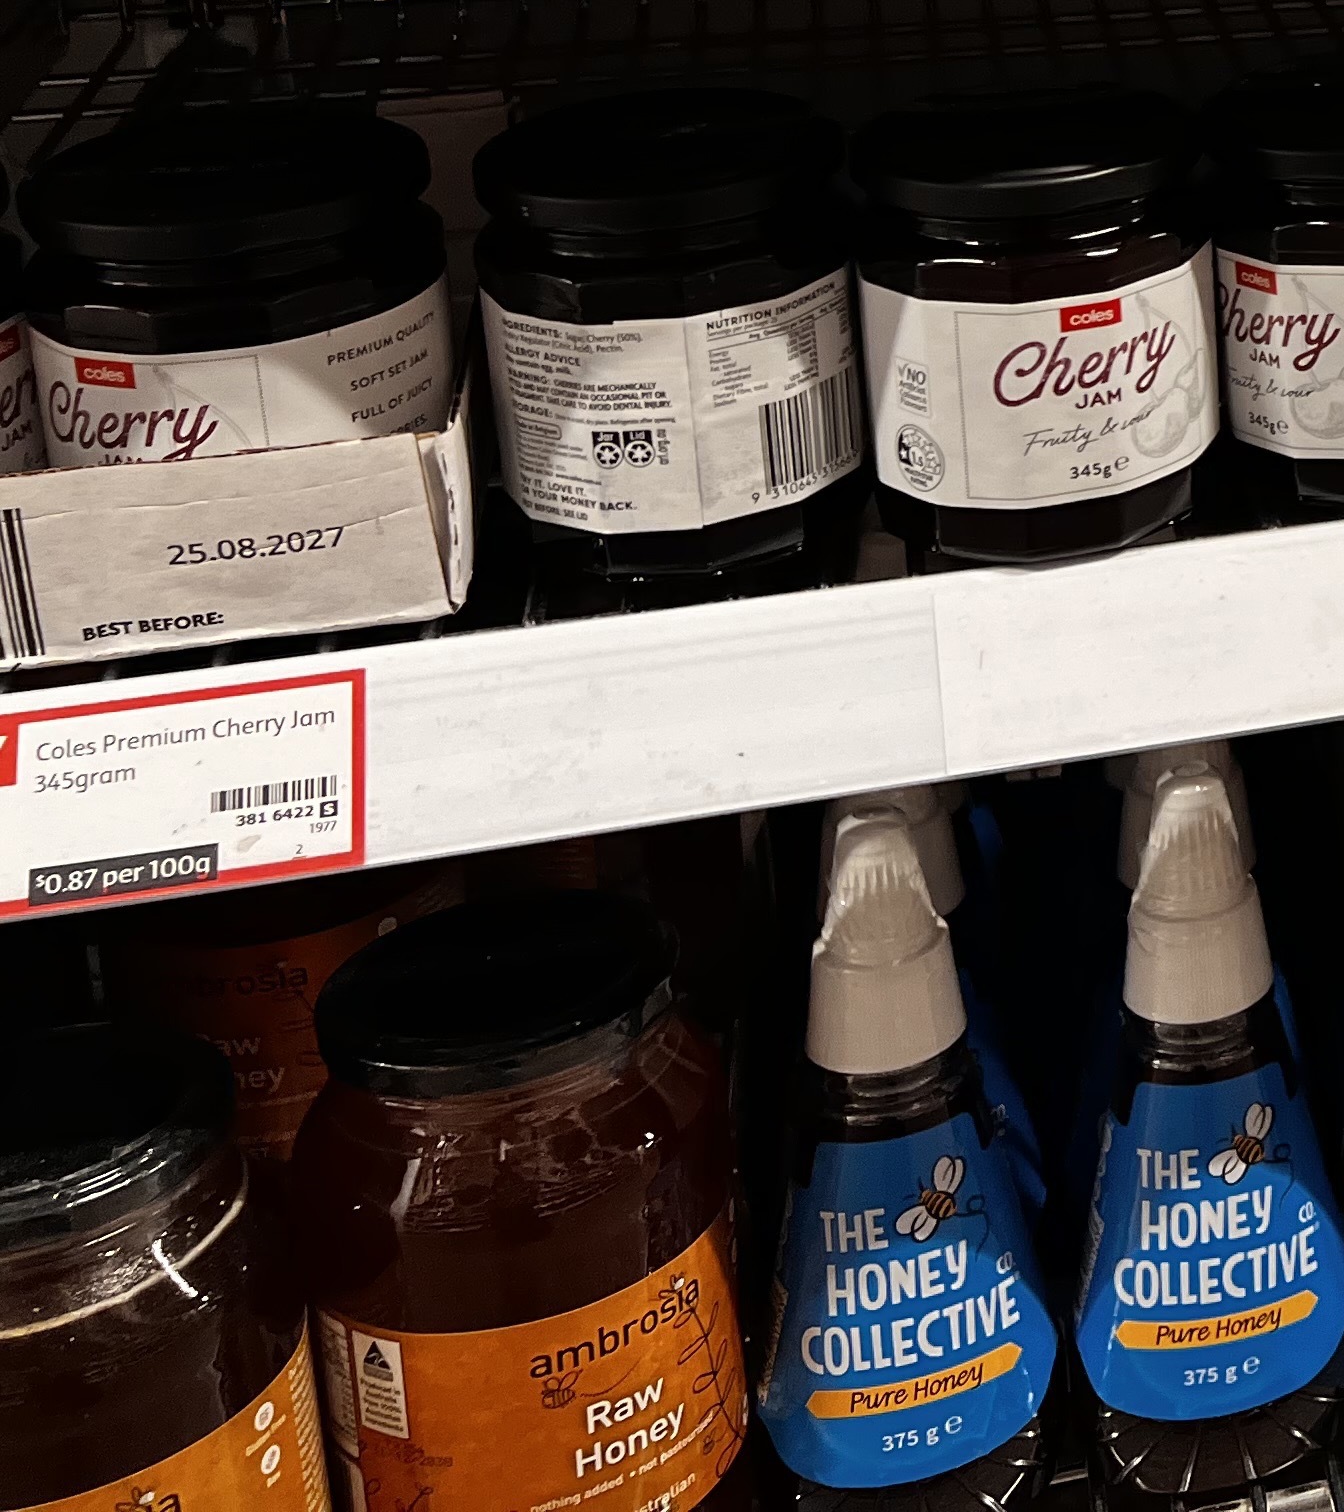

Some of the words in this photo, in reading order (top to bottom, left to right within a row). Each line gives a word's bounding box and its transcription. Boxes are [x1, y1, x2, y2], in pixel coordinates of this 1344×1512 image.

[1068, 306, 1115, 325] coles
[994, 318, 1175, 409] Cherry
[1075, 386, 1123, 410] JAM
[1070, 462, 1112, 482] 345g
[166, 526, 345, 567] 25.08.2027
[82, 619, 134, 642] BEST
[137, 610, 226, 636] BEFORE:
[35, 735, 98, 762] Coles
[103, 724, 207, 755] Premium
[211, 715, 287, 745] Cherry
[291, 706, 336, 731] Jam
[33, 762, 138, 795] 345gram
[1113, 1227, 1319, 1309] COLLECTIVE
[529, 1277, 701, 1380] ambrosia
[585, 1379, 664, 1435] Raw
[574, 1403, 687, 1478] Honey
